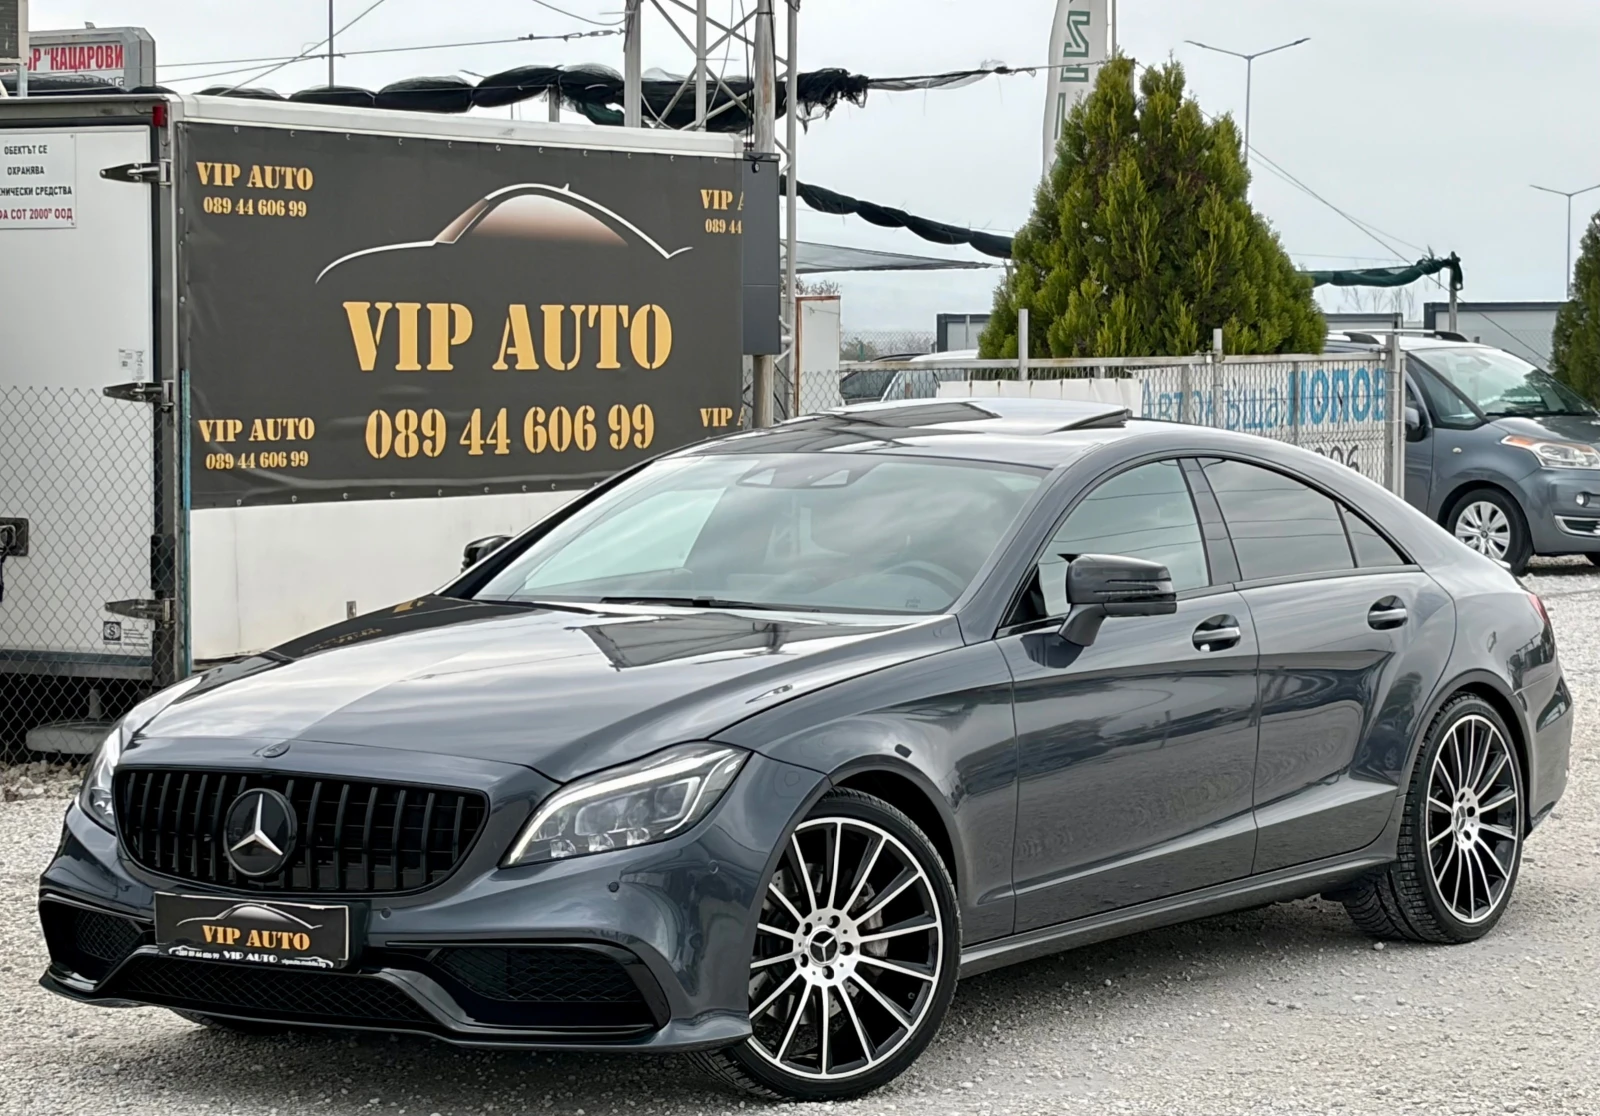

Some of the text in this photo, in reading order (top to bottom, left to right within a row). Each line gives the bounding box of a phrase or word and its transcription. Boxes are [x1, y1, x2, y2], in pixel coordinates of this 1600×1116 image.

[4, 145, 48, 155] ОБЕКТЪТ СЕ
[7, 166, 45, 175] ОХРАНЯВА
[196, 161, 313, 190] VIP AUTO
[35, 186, 72, 197] СРЕДСТВА
[700, 188, 733, 210] VIP
[11, 209, 27, 220] СОТ
[54, 208, 73, 221] ООД
[203, 196, 307, 217] 089 44 606 99
[705, 218, 742, 234] 089 44
[342, 301, 673, 371] VIP AUTO
[700, 407, 733, 427] VIP
[198, 417, 315, 442] VIP AUTO
[365, 403, 655, 459] 089 44 606 99
[206, 450, 309, 470] 089 44 606 99
[202, 924, 311, 951] VIP AUTO
[223, 951, 244, 961] VIP
[245, 953, 278, 964] AUTO
